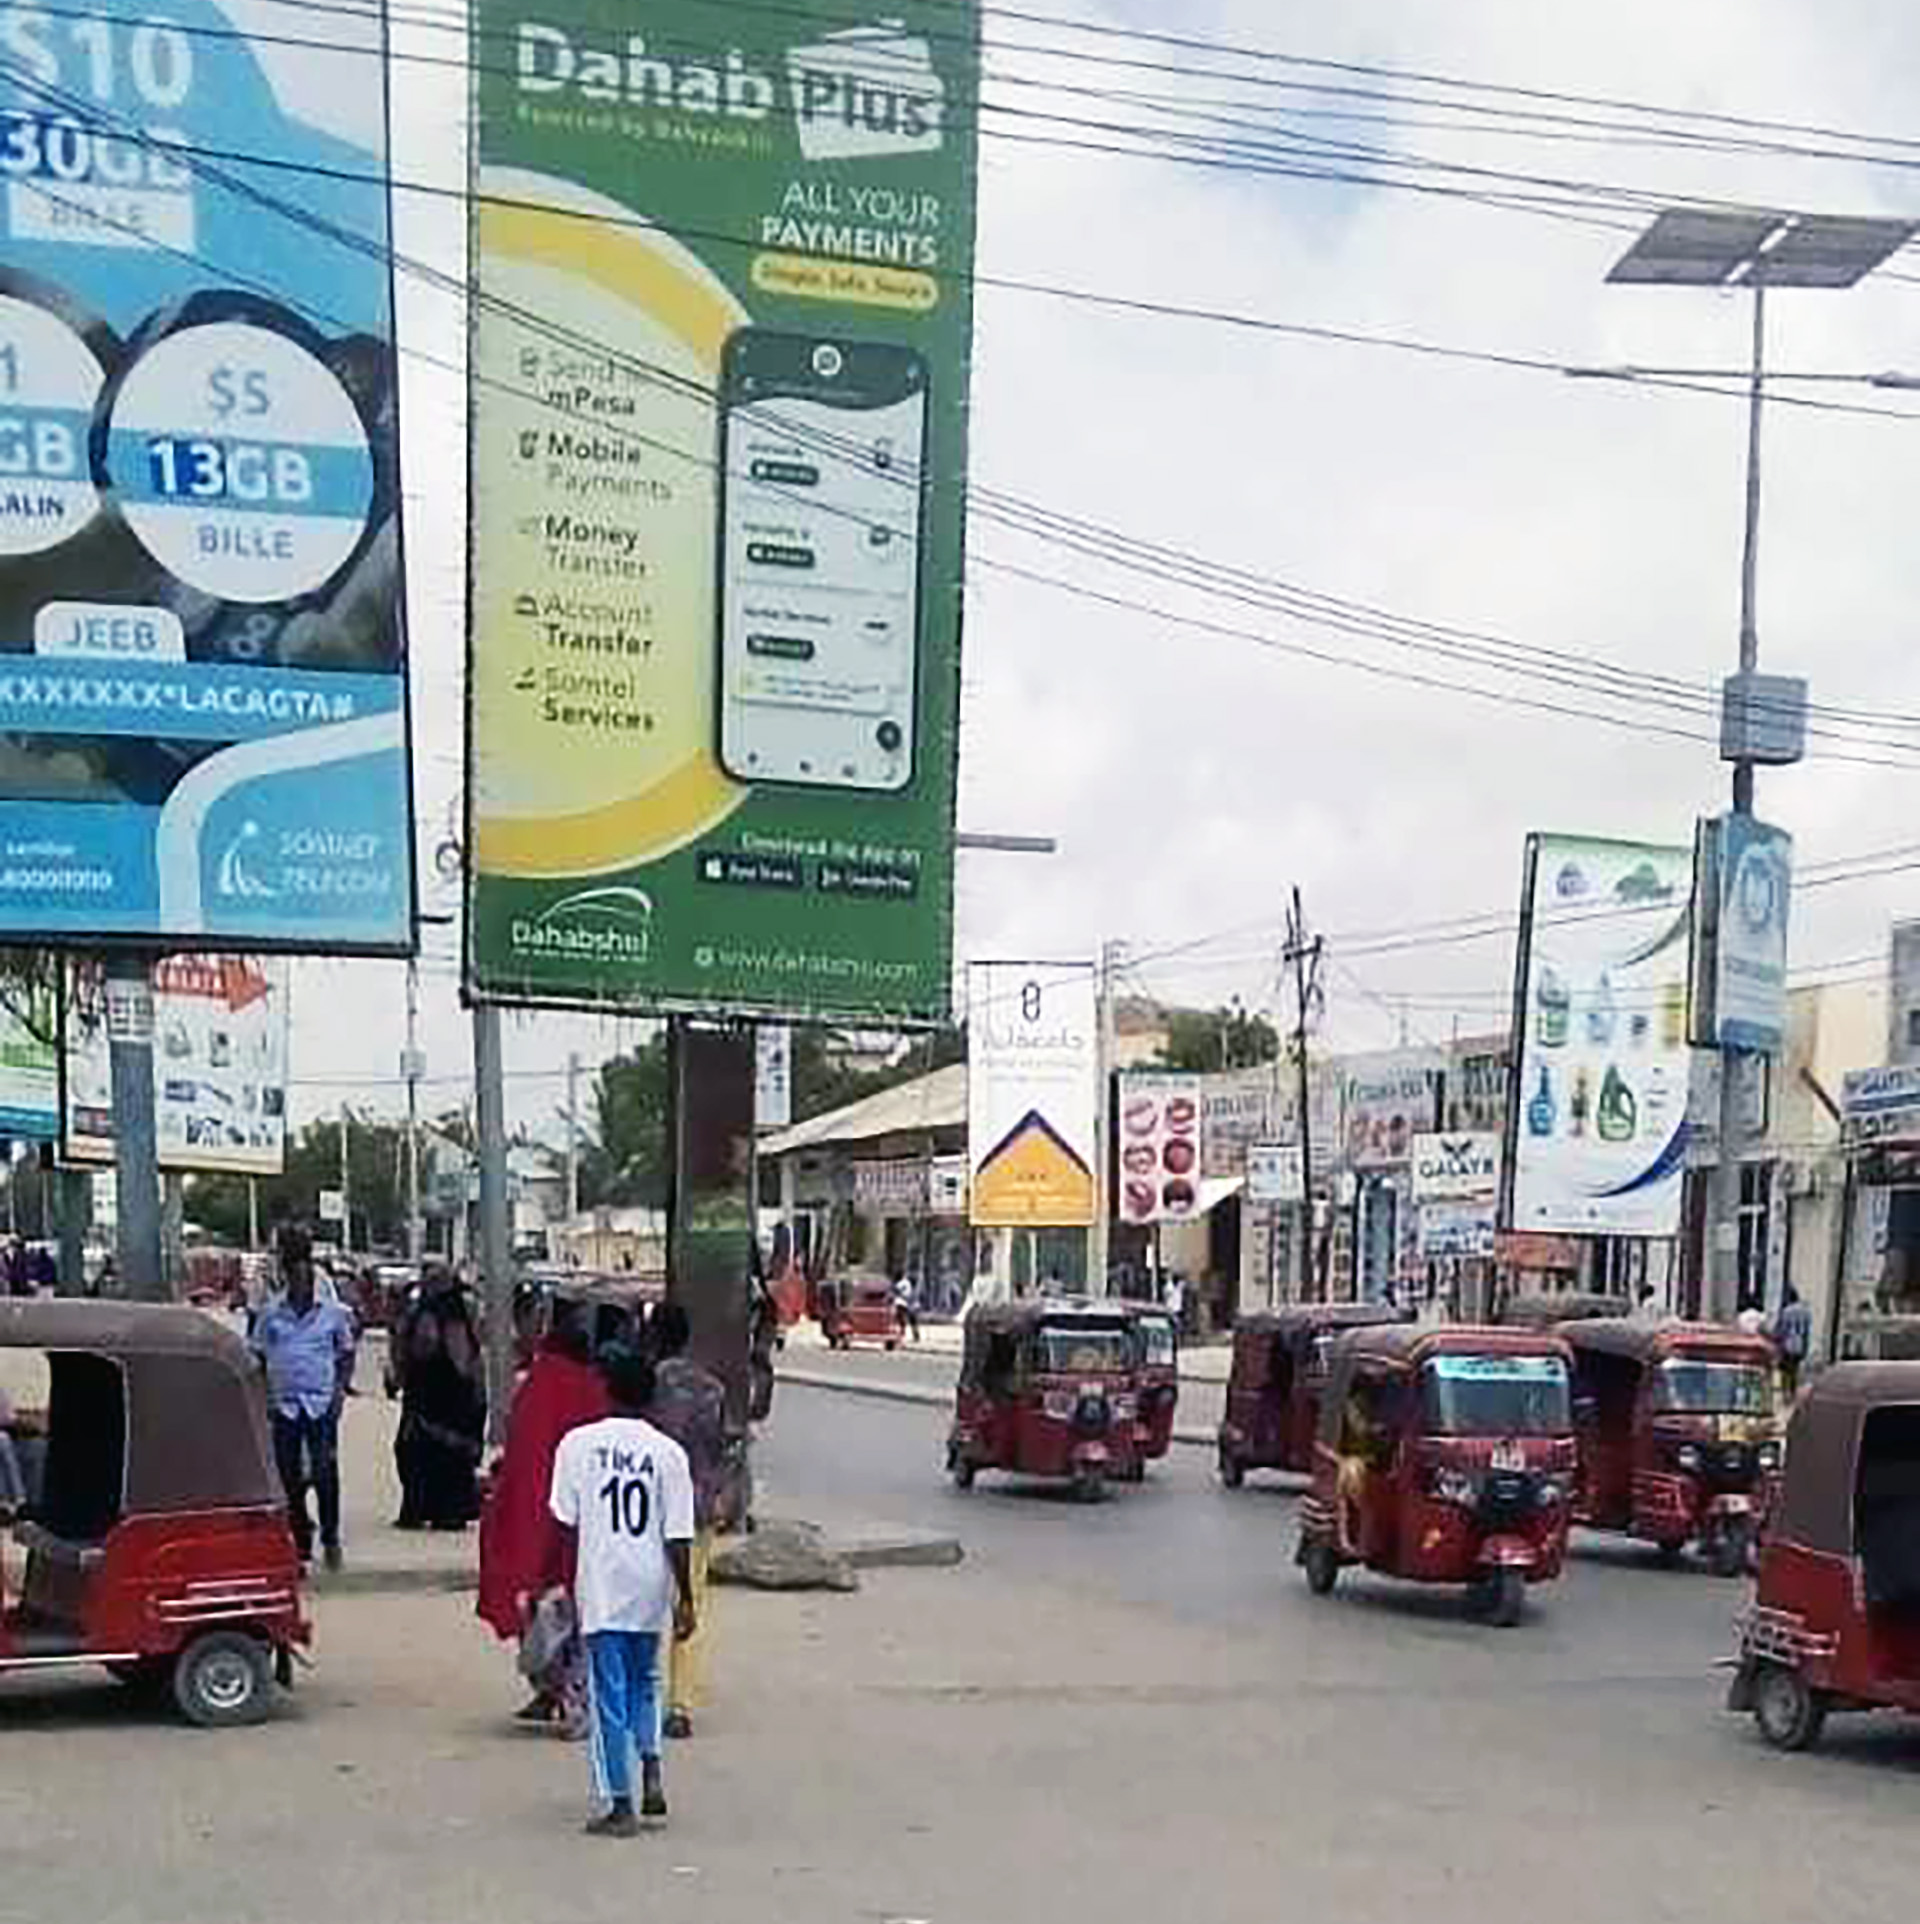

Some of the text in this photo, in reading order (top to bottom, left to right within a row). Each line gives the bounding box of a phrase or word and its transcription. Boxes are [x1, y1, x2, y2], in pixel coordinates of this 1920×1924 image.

[518, 22, 773, 119] Dahab
[780, 181, 940, 227] ALL YOUR
[762, 215, 938, 266] PAYMENTS
[549, 429, 640, 464] Mobile
[148, 436, 313, 501] 13GB
[0, 493, 64, 518] ALIN
[199, 524, 294, 560] BILLE
[546, 514, 637, 551] Money
[71, 615, 158, 651] JEEB
[546, 623, 652, 655] Transfer
[545, 697, 653, 732] Services
[600, 1475, 650, 1538] 10
